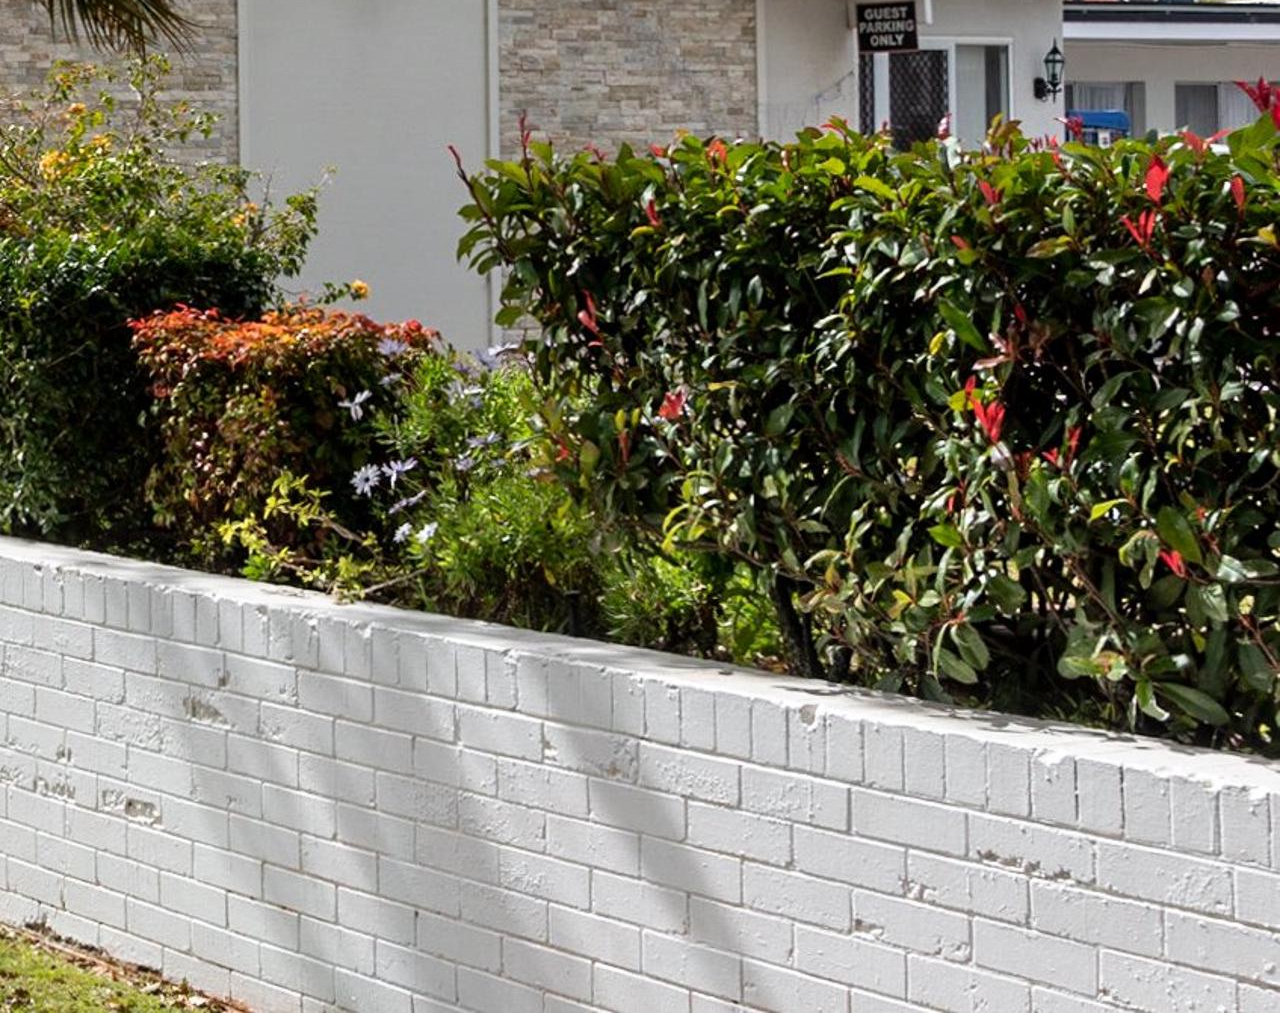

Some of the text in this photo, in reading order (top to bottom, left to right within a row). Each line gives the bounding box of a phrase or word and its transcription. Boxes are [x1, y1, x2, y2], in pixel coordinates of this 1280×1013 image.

[864, 6, 909, 20] GUEST
[859, 19, 914, 33] PARKING
[869, 33, 905, 47] ONLY
